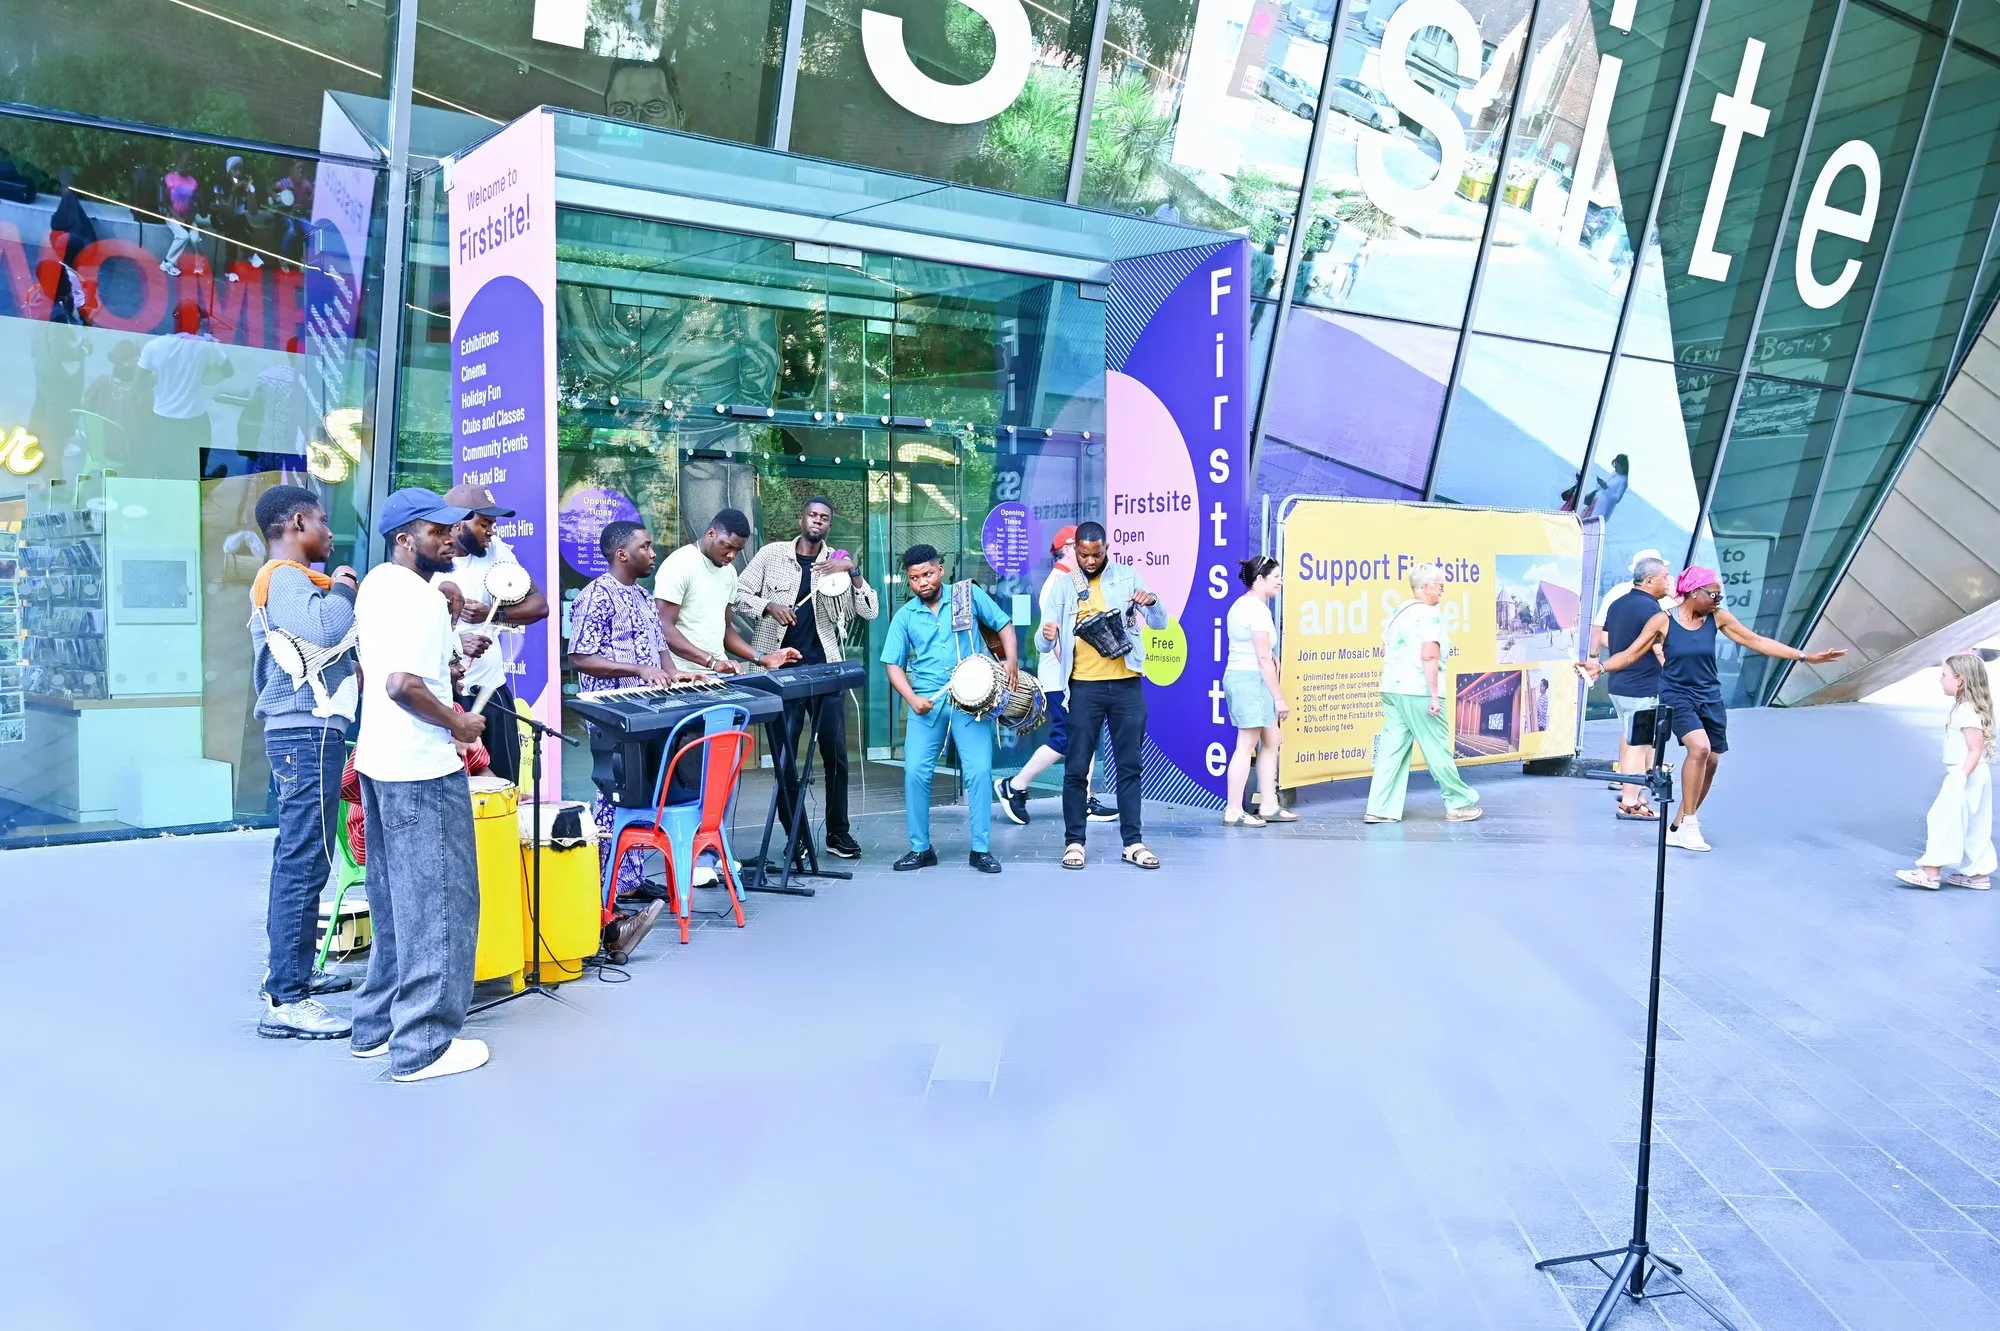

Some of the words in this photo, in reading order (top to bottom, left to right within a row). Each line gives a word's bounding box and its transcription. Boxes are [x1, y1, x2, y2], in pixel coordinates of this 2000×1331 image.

[467, 176, 506, 211] Welcome
[507, 167, 518, 188] to
[459, 193, 531, 265] Firstsite!
[461, 330, 500, 356] Exhibitions
[461, 362, 487, 383] Cinema
[461, 388, 487, 409] Holiday
[487, 384, 502, 400] Fun
[462, 415, 481, 436] Clubs
[482, 412, 495, 431] and
[496, 407, 525, 428] Classes
[463, 439, 502, 462] Community
[502, 433, 528, 453] Events
[480, 468, 493, 485] and
[494, 466, 507, 483] Bar
[583, 496, 617, 506] Opening
[1114, 490, 1191, 515] Firstsite
[588, 508, 612, 516] Times
[1000, 509, 1025, 518] Opening
[517, 519, 534, 537] Hire
[1204, 266, 1232, 778] Firstsite
[1113, 528, 1145, 545] Open
[1113, 552, 1134, 566] Tue
[1145, 551, 1170, 566] Sun
[1722, 547, 1746, 563] to
[1299, 552, 1390, 586] Support
[1398, 554, 1480, 583] Fsite
[1722, 569, 1752, 584] ost
[1299, 589, 1369, 635] and
[1381, 592, 1471, 634] Se!
[1151, 636, 1174, 650] Free
[1145, 652, 1181, 663] Admission
[1297, 650, 1318, 662] Join
[1320, 651, 1336, 661] our
[1338, 648, 1370, 660] Mosaic
[1448, 646, 1460, 657] et:
[503, 660, 526, 675] site.uk
[1303, 671, 1335, 682] Unlimited
[1335, 672, 1349, 680] free
[1302, 682, 1338, 692] screenings
[1338, 681, 1345, 689] in
[1357, 680, 1380, 688] cinema
[1303, 693, 1317, 702] 20%
[1317, 692, 1327, 701] off
[1345, 691, 1366, 699] cinema
[1303, 704, 1318, 713] 20%
[1318, 703, 1328, 711] off
[1341, 701, 1373, 711] workshops
[1304, 715, 1318, 723] 10%
[1318, 714, 1328, 722] off
[1329, 713, 1336, 721] in
[1336, 712, 1348, 721] the
[1348, 710, 1374, 720] Firstsite
[1303, 725, 1313, 733] No
[1314, 723, 1340, 734] booking
[1340, 722, 1354, 731] fees
[1295, 751, 1315, 763] Join
[1318, 749, 1339, 761] here
[1341, 747, 1367, 760] today
